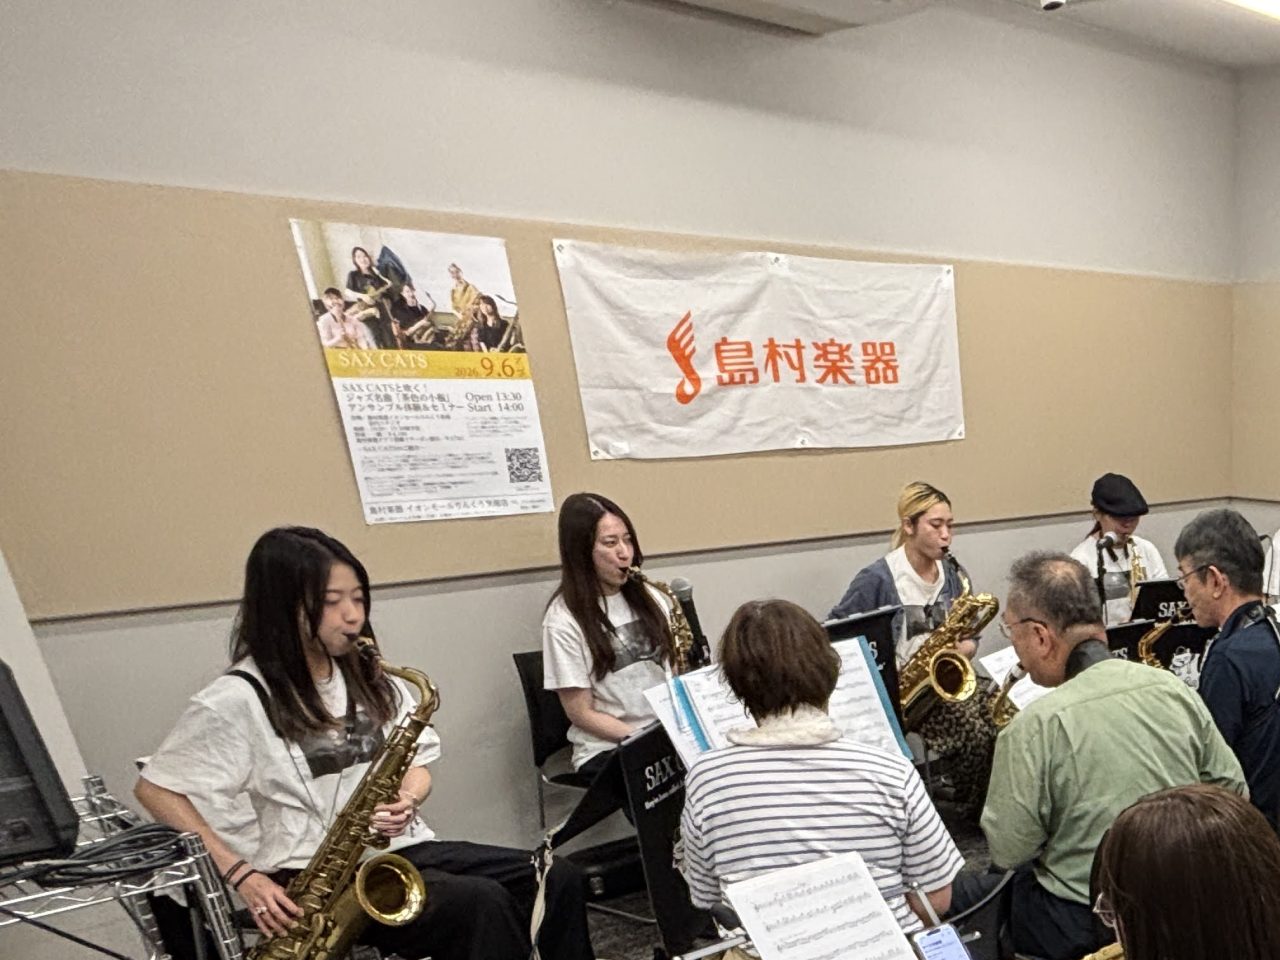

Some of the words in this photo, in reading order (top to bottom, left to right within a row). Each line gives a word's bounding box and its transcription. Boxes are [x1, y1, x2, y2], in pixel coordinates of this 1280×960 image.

[339, 351, 376, 368] SAX
[380, 352, 428, 369] CATS
[480, 357, 515, 378] 9.6
[714, 336, 899, 387] 島村楽器
[465, 392, 493, 403] Open
[496, 392, 522, 401] 13:30
[467, 403, 492, 412] Start
[498, 403, 524, 412] 14:00
[644, 755, 676, 791] SAX
